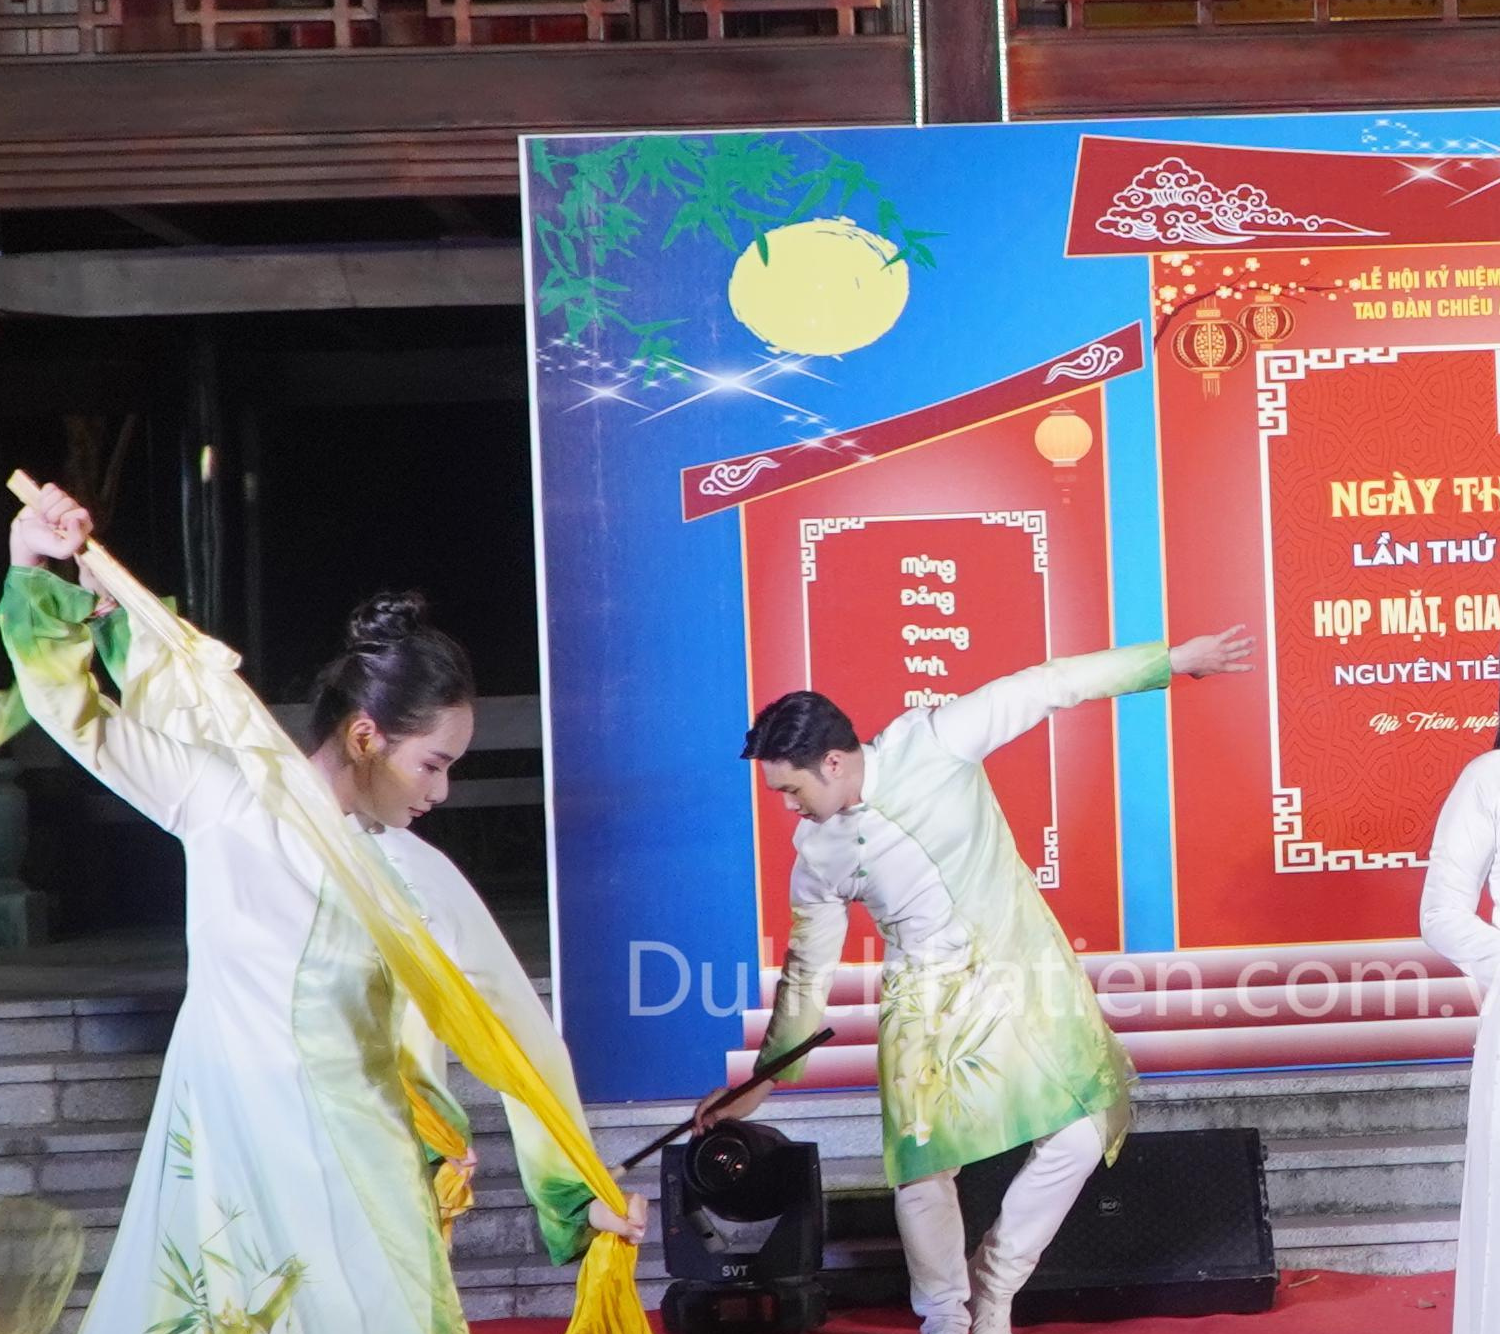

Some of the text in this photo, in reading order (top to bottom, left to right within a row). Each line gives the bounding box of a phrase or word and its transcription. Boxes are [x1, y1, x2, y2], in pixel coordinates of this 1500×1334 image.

[1360, 265, 1383, 291] LỄ
[1388, 267, 1420, 291] HỘI
[1353, 301, 1386, 320] TAO
[1392, 297, 1432, 319] ĐÀN
[1438, 295, 1492, 317] CHIÊU
[1330, 472, 1442, 517] NGÀY
[1352, 532, 1419, 567] LẦN
[1426, 531, 1496, 563] THỨ
[1313, 599, 1371, 643] HỌP
[1380, 589, 1447, 641] MẶT,
[902, 625, 969, 650] Quang
[904, 656, 948, 676] Vinh
[1334, 657, 1449, 686] NGUYÊN
[1457, 656, 1500, 682] TIÊ
[1369, 713, 1401, 735] Hà
[1407, 712, 1459, 731] Tiên,
[1463, 712, 1499, 737] ngà
[721, 1265, 748, 1277] SVT
